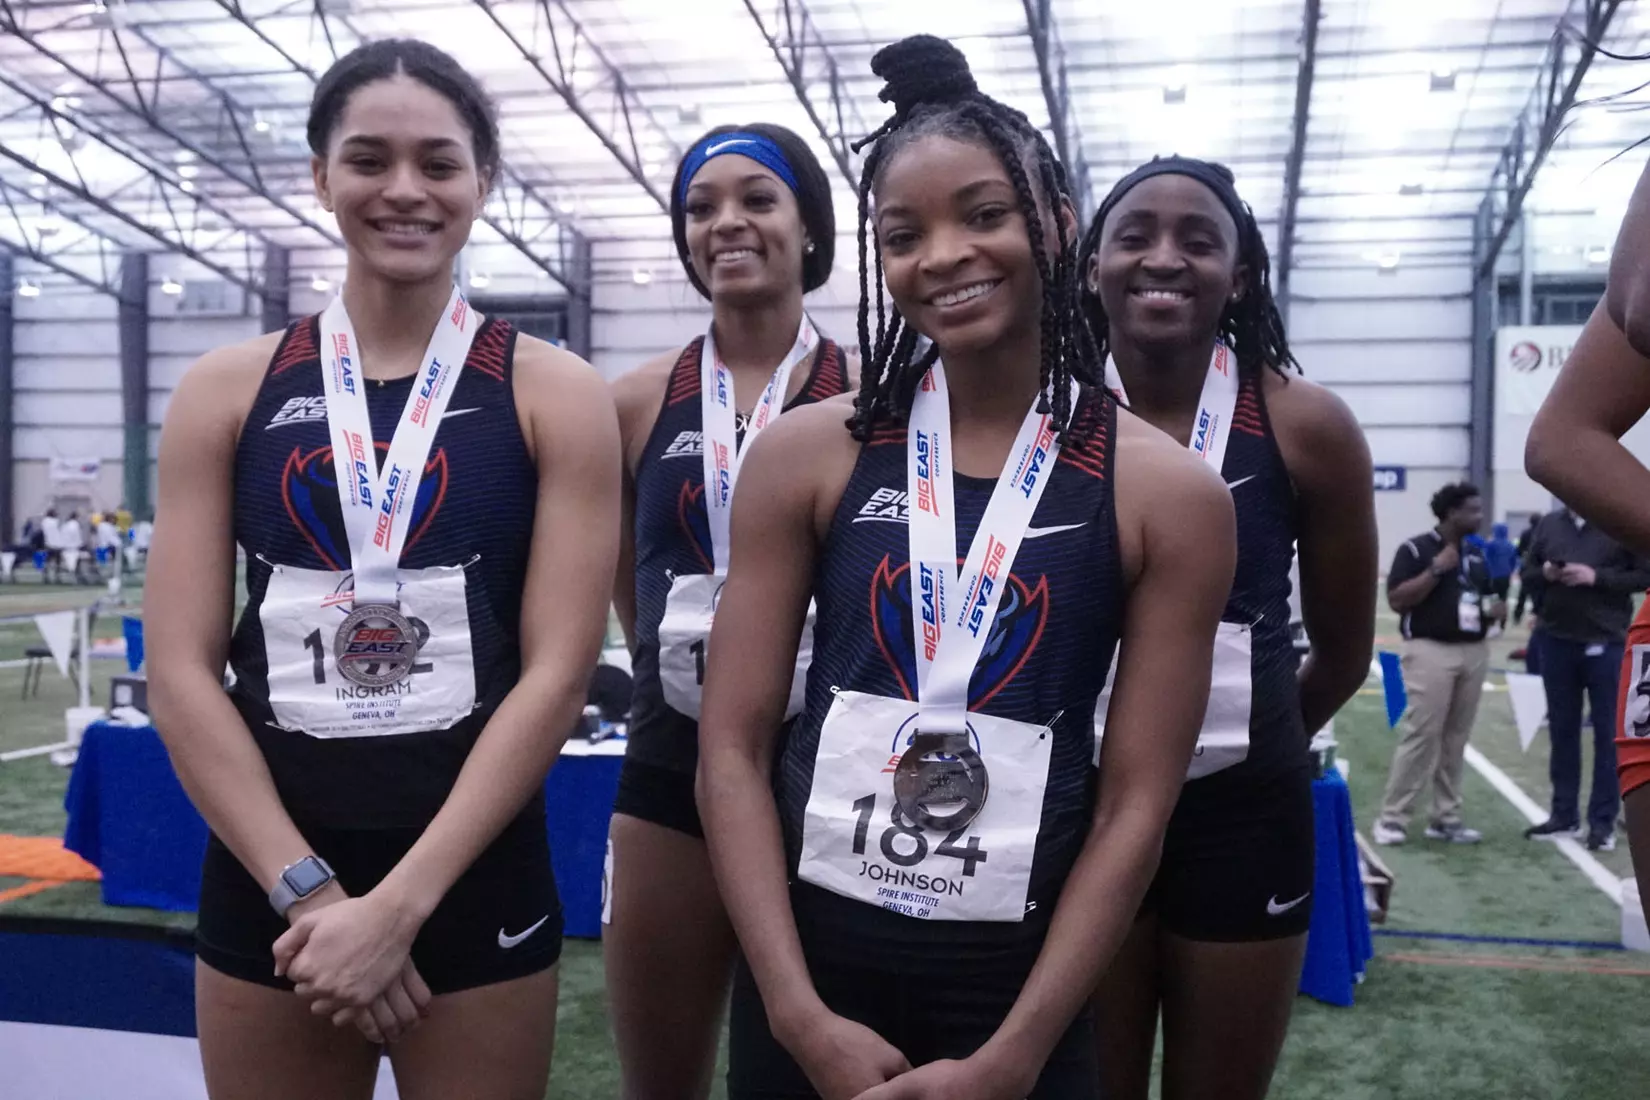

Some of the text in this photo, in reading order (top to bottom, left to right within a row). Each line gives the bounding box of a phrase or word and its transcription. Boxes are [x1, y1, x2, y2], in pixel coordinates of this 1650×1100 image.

[450, 298, 465, 326] BIG
[338, 333, 356, 396] BIG EAST
[410, 357, 442, 424] BIG EAST
[717, 368, 727, 408] EAST
[270, 408, 328, 423] EAS
[1195, 408, 1211, 452] EAST
[352, 432, 373, 510] BIG EAST
[719, 443, 729, 470] BIG
[916, 430, 931, 513] BIG EAST
[933, 432, 941, 477] CONFERENCE
[1020, 446, 1046, 499] EAST
[373, 463, 402, 548] BIG EAST
[938, 569, 946, 624] CONFERENCE
[957, 574, 977, 628] CONFERENCE
[967, 541, 1007, 638] BIG EAST
[920, 562, 937, 662] BIG EAST
[346, 642, 408, 653] EAST
[352, 629, 401, 642] BIG
[336, 680, 412, 700] INGRAM
[384, 710, 396, 719] OH
[851, 793, 988, 878] 184
[859, 861, 964, 897] JOHNSON
[877, 887, 940, 908] SPIRE INSTITUTE
[882, 901, 931, 918] GENEVA, OH
